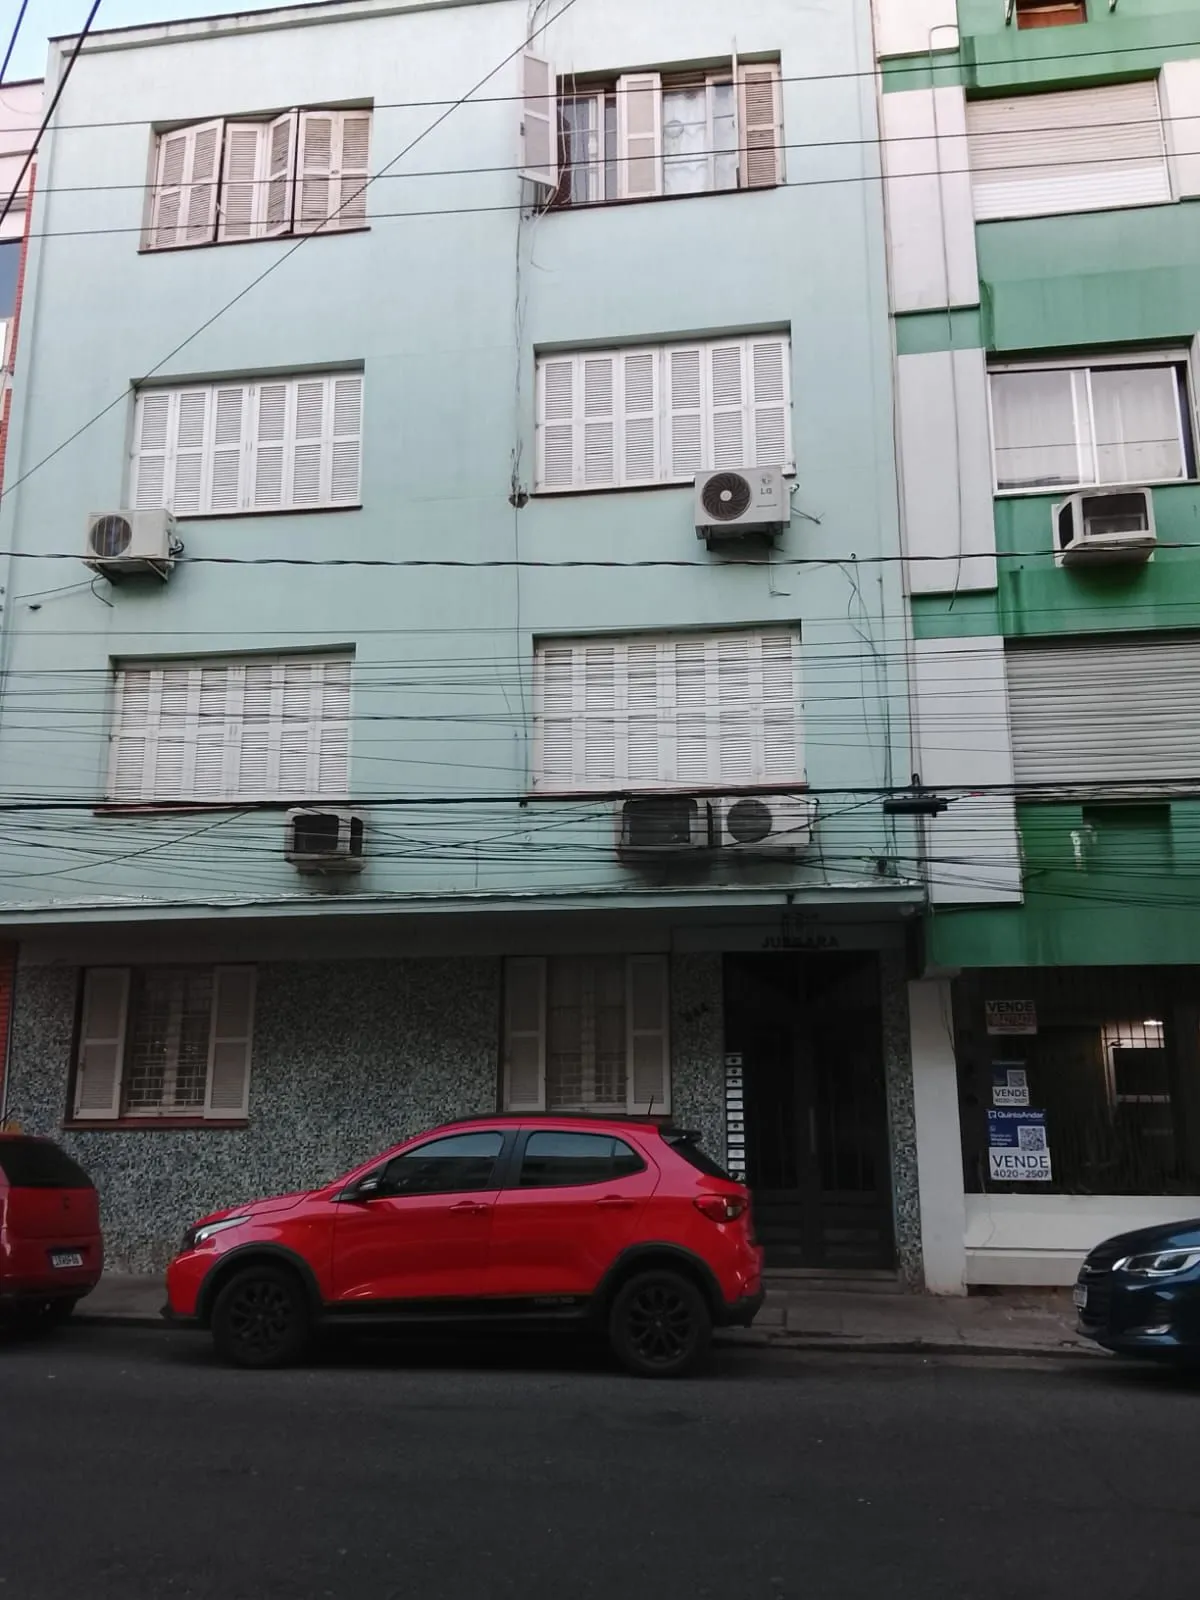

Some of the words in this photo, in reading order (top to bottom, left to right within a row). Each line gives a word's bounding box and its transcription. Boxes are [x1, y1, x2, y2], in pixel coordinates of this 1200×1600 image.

[761, 935, 839, 948] JUARA
[987, 1002, 1033, 1012] VENDE
[994, 1089, 1027, 1097] VENDE
[992, 1155, 1049, 1168] VENDE
[993, 1169, 1049, 1178] 4020-2507
